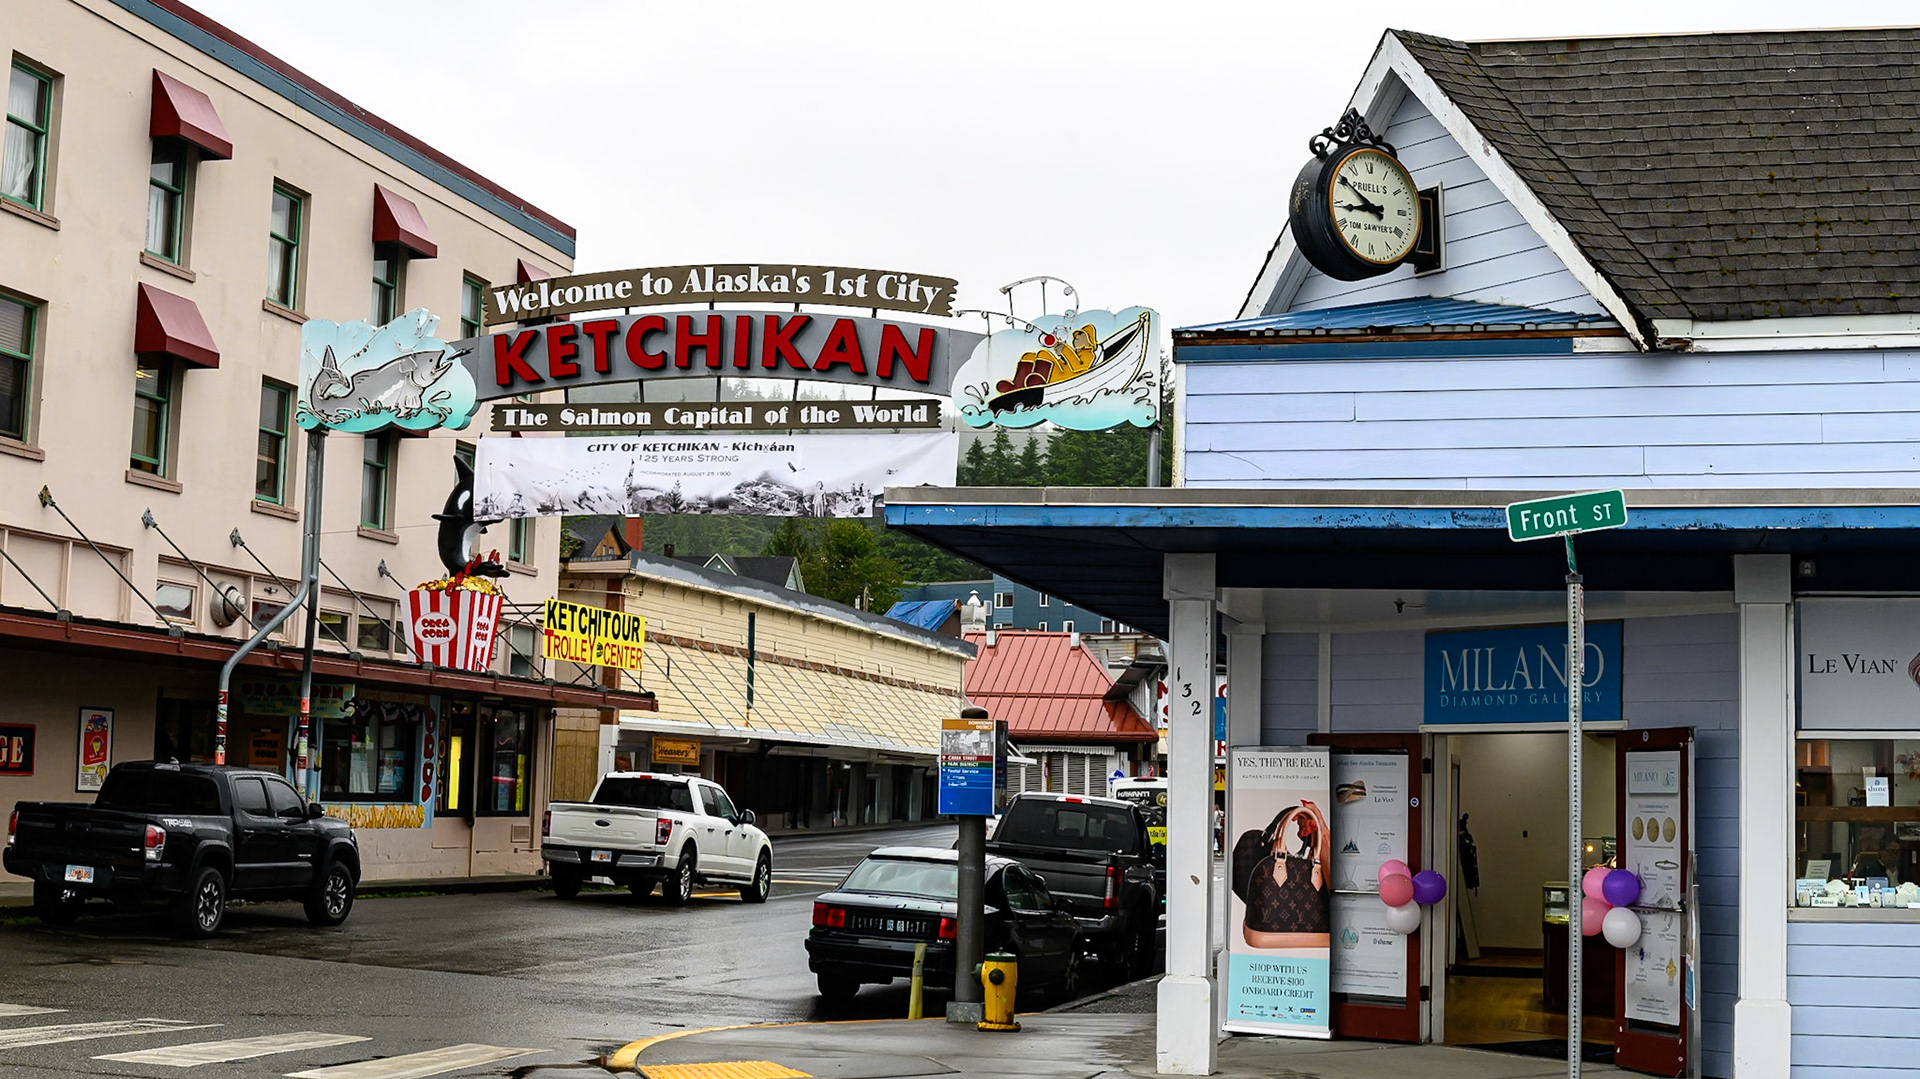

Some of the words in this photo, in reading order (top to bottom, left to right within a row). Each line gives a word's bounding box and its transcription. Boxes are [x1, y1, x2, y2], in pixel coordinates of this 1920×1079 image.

[1352, 181, 1388, 195] PRUELL'S
[1349, 220, 1362, 230] TOM
[1363, 223, 1393, 234] SAWYER'S
[493, 279, 633, 315] Welcome
[641, 271, 674, 296] to
[680, 265, 811, 294] Alaska's
[821, 270, 869, 298] 1st
[876, 273, 942, 313] City
[493, 314, 937, 386] KETCHIKAN
[502, 408, 548, 426] The
[560, 407, 652, 426] Salmon
[663, 406, 753, 429] Capital
[764, 405, 789, 426] of
[800, 405, 840, 424] the
[852, 404, 928, 424] World
[587, 443, 618, 452] CITY
[621, 443, 640, 452] OF
[642, 442, 720, 452] KETCHIKAN
[639, 454, 658, 462] 125
[662, 454, 694, 462] YEARS
[697, 453, 739, 462] STRONG
[1520, 504, 1578, 532] Front
[1592, 503, 1612, 521] ST
[421, 618, 450, 628] ORCA
[547, 600, 640, 643] KETCHITOUR
[421, 629, 450, 638] CORN
[544, 628, 597, 663] TROLLEY
[603, 642, 643, 669] CENTER
[1440, 641, 1605, 693] MILANO
[1440, 693, 1518, 708] DIAMOND
[1529, 691, 1603, 705] GALLRY
[1249, 962, 1272, 973] SHOP
[1272, 964, 1296, 974] WITH
[1296, 965, 1308, 975] US
[1251, 975, 1286, 985] RECEIVE
[1241, 986, 1283, 997] ONBOARD
[1283, 988, 1315, 999] CREDIT
